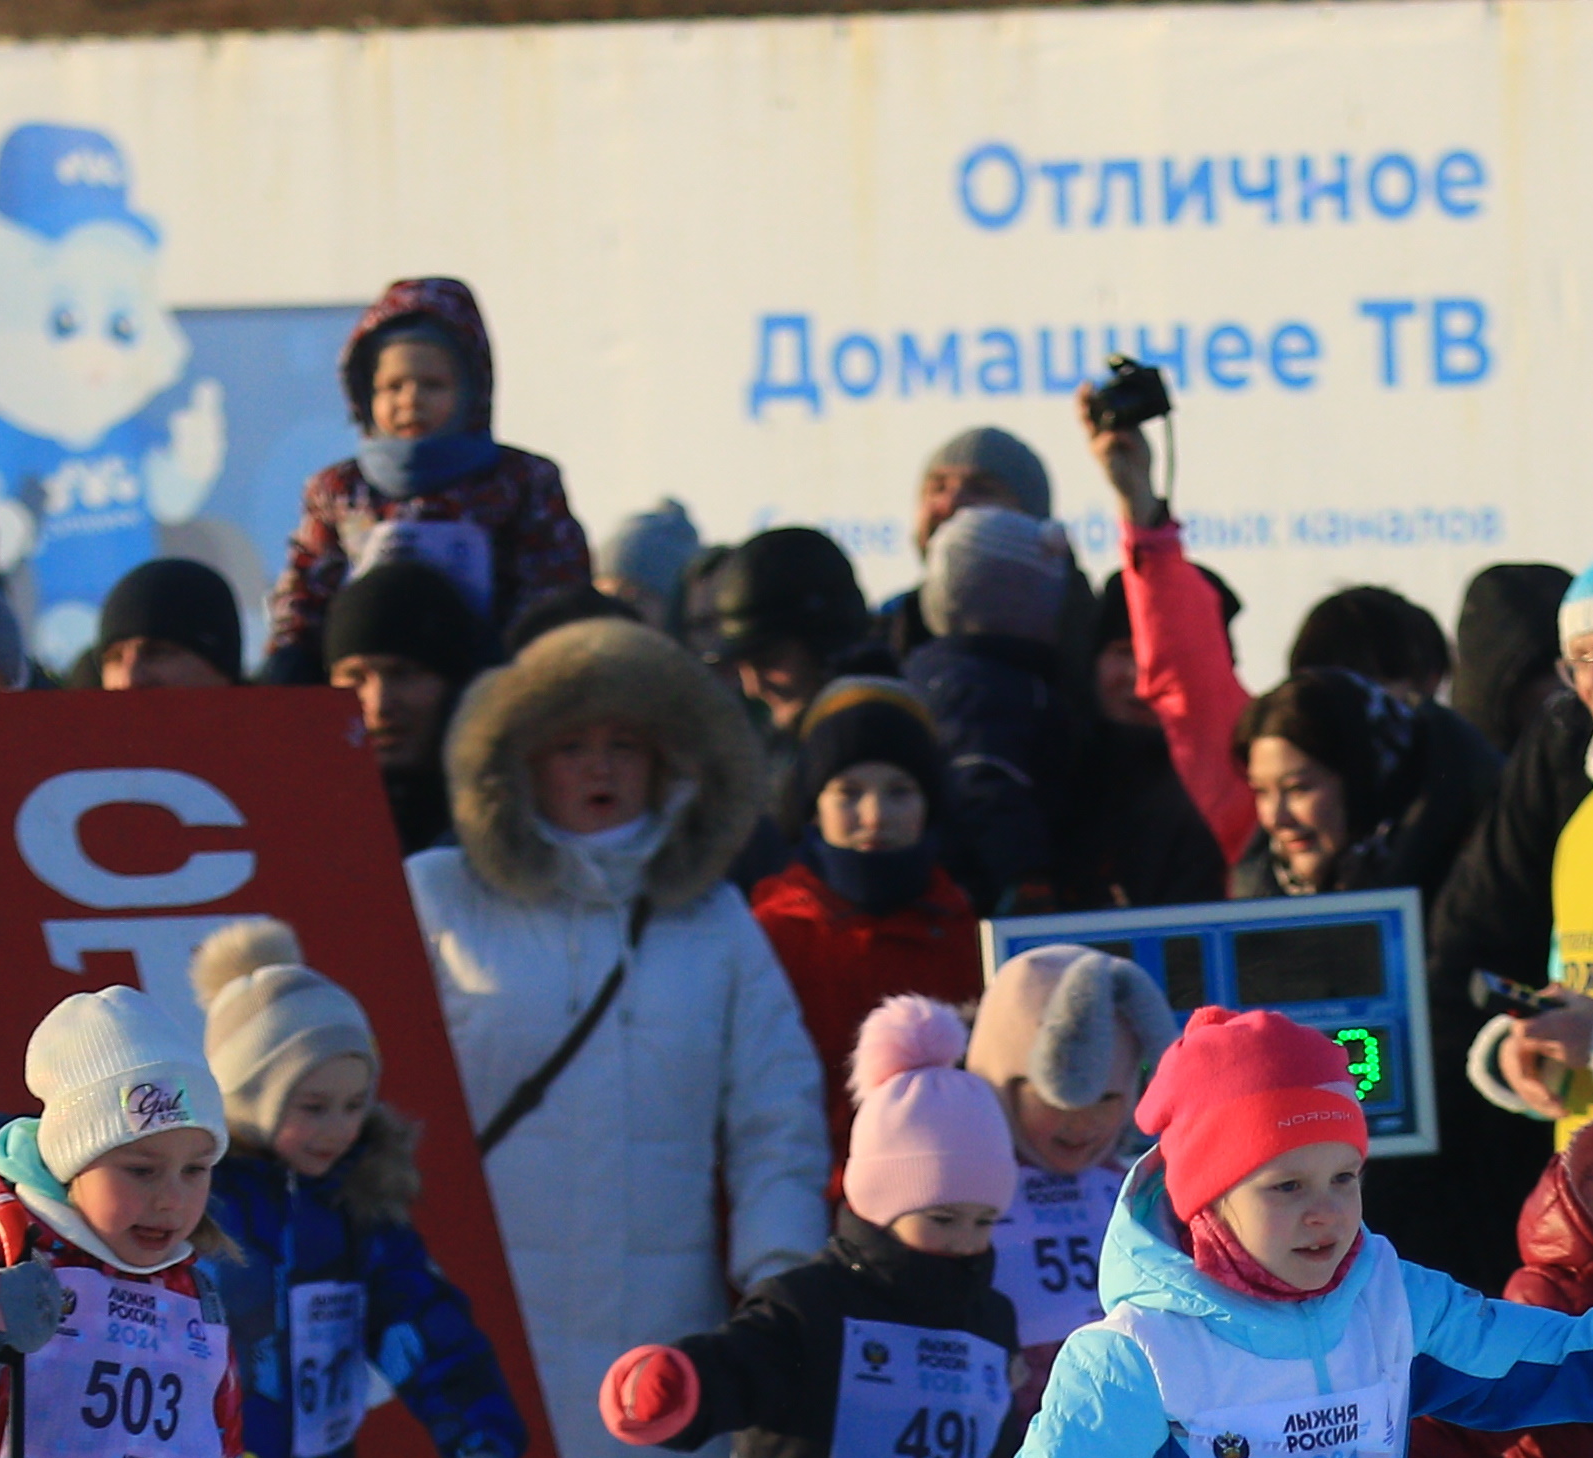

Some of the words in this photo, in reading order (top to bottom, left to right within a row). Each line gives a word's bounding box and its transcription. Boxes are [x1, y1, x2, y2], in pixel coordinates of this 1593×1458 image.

[956, 142, 1487, 231] Отличное
[746, 312, 1324, 420] Домашнее
[1358, 296, 1494, 388] ТВ
[126, 1083, 185, 1130] Girl
[108, 1286, 156, 1309] ЛЫЖНЯ
[108, 1301, 157, 1327] РОССИИ
[108, 1323, 158, 1351] 2024
[81, 1360, 182, 1441] 503
[1283, 1403, 1359, 1434] ЛЫЖНЯ
[1286, 1422, 1359, 1454] РОССИИ
